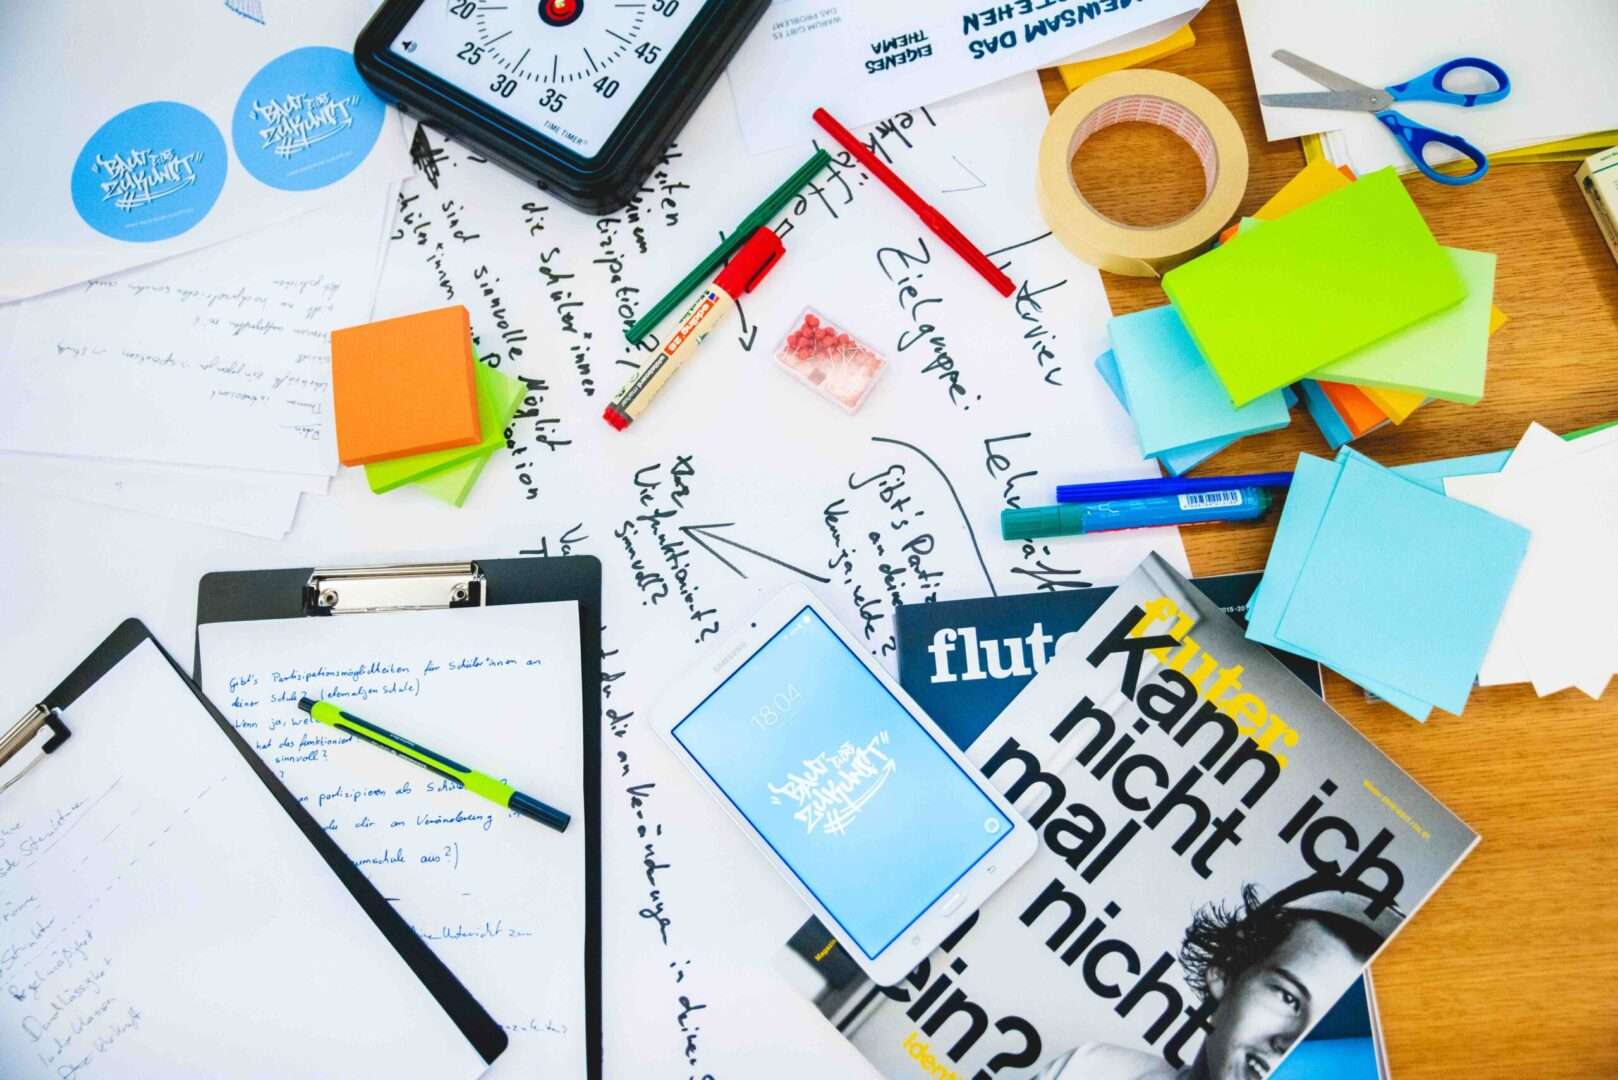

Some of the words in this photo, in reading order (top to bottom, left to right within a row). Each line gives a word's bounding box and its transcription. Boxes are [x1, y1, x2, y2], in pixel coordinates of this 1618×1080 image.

[450, 0, 475, 20] 20
[961, 0, 1072, 35] TEHEN
[870, 28, 928, 55] THEMA
[968, 32, 1018, 60] DAS
[1023, 0, 1146, 45] MEINSAM
[457, 42, 485, 66] 25
[634, 41, 661, 65] 45
[865, 43, 934, 75] EIGENES
[490, 74, 517, 98] 30
[538, 88, 567, 113] 35
[592, 76, 619, 99] 40
[441, 199, 481, 243] sind
[1085, 604, 1282, 810] Kann
[1277, 778, 1406, 920] ich
[1049, 695, 1247, 880] nicht
[980, 736, 1143, 885] mal
[1018, 877, 1217, 1070] nicht
